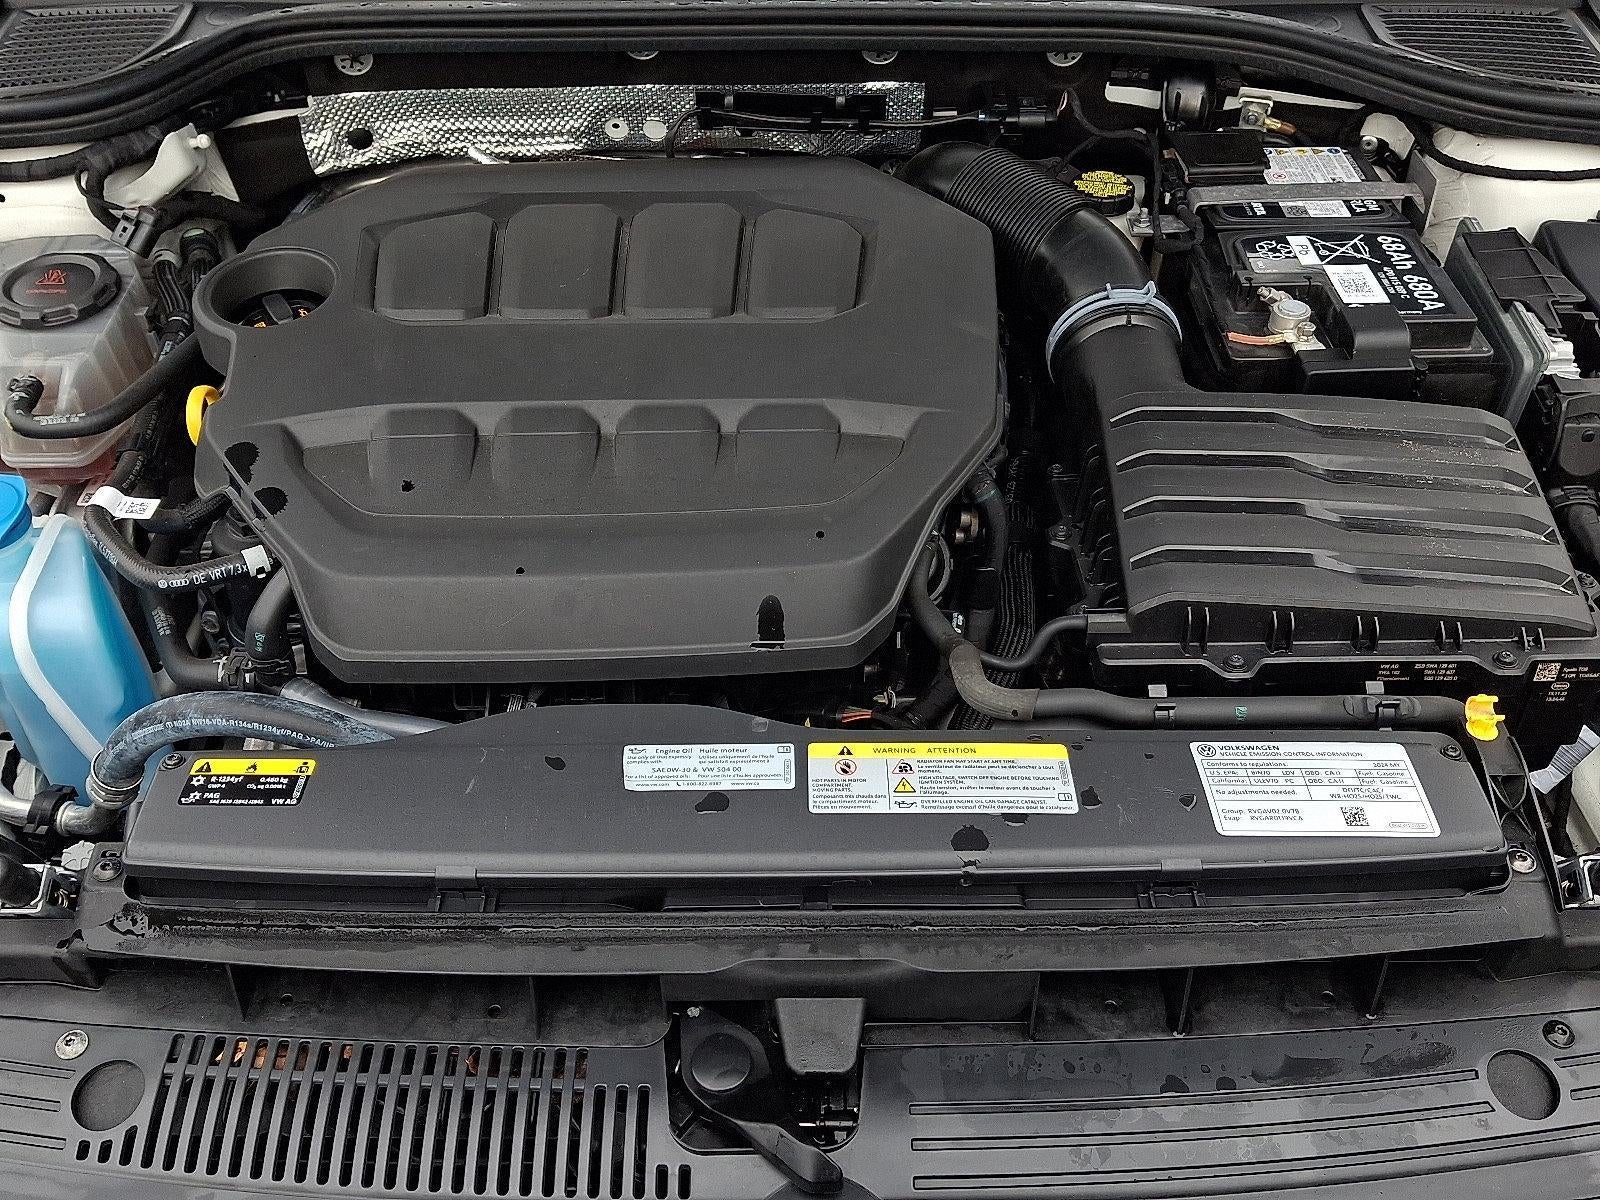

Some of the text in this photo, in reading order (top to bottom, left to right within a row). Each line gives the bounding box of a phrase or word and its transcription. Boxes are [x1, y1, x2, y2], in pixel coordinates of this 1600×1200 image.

[1363, 199, 1381, 212] GM
[1296, 244, 1309, 255] Pb
[1376, 236, 1417, 270] 68Ah
[1402, 274, 1446, 310] 680A
[192, 573, 207, 585] DE
[208, 566, 228, 581] VRT
[228, 563, 248, 576] 7,3x
